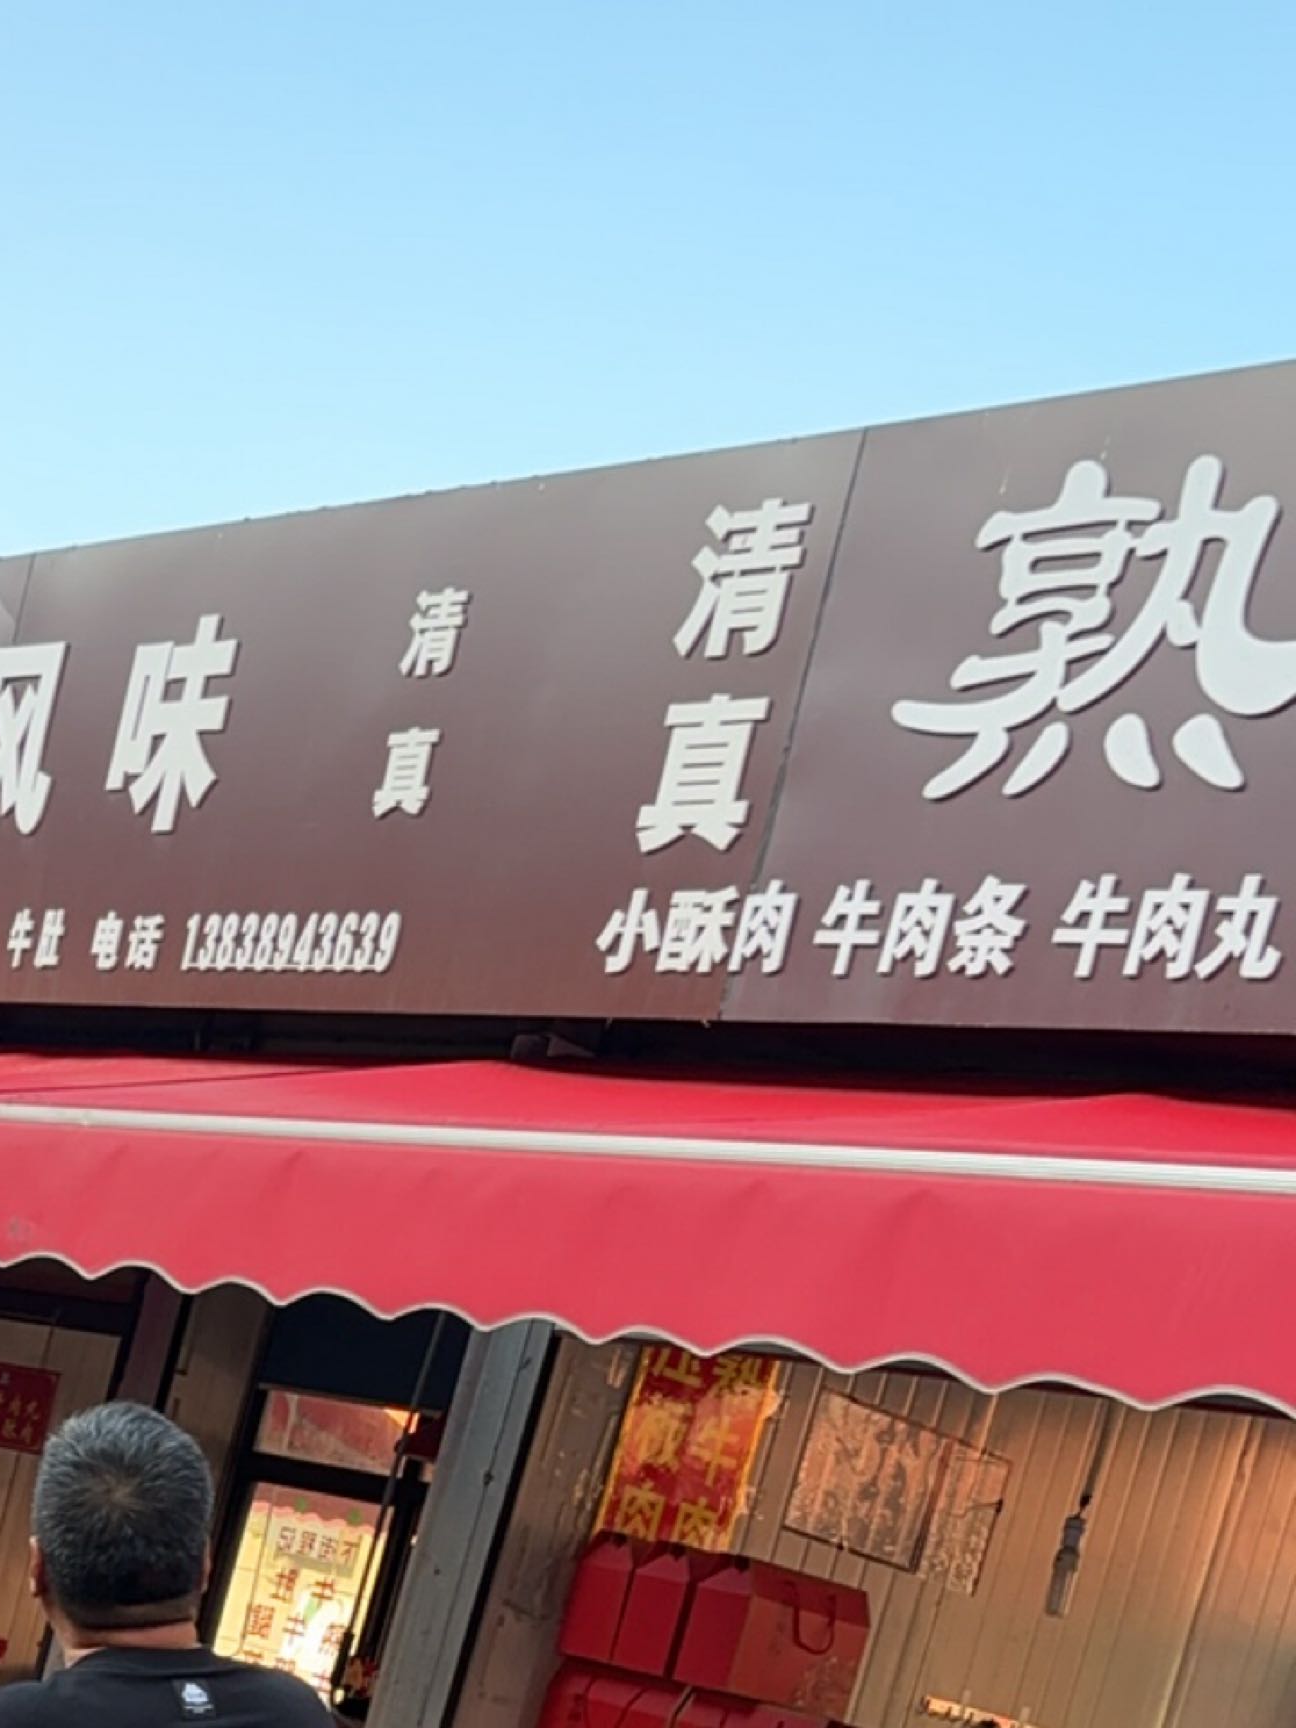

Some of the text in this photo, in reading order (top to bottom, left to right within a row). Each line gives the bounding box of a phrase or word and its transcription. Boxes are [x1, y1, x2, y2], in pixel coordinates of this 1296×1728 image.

[372, 588, 469, 818] 清真
[636, 497, 812, 853] 清真
[891, 454, 1296, 801] 熟
[90, 911, 165, 972] 电话
[180, 911, 402, 973] 13838943639
[596, 873, 1281, 979] 小酥肉 牛肉条 牛肉丸
